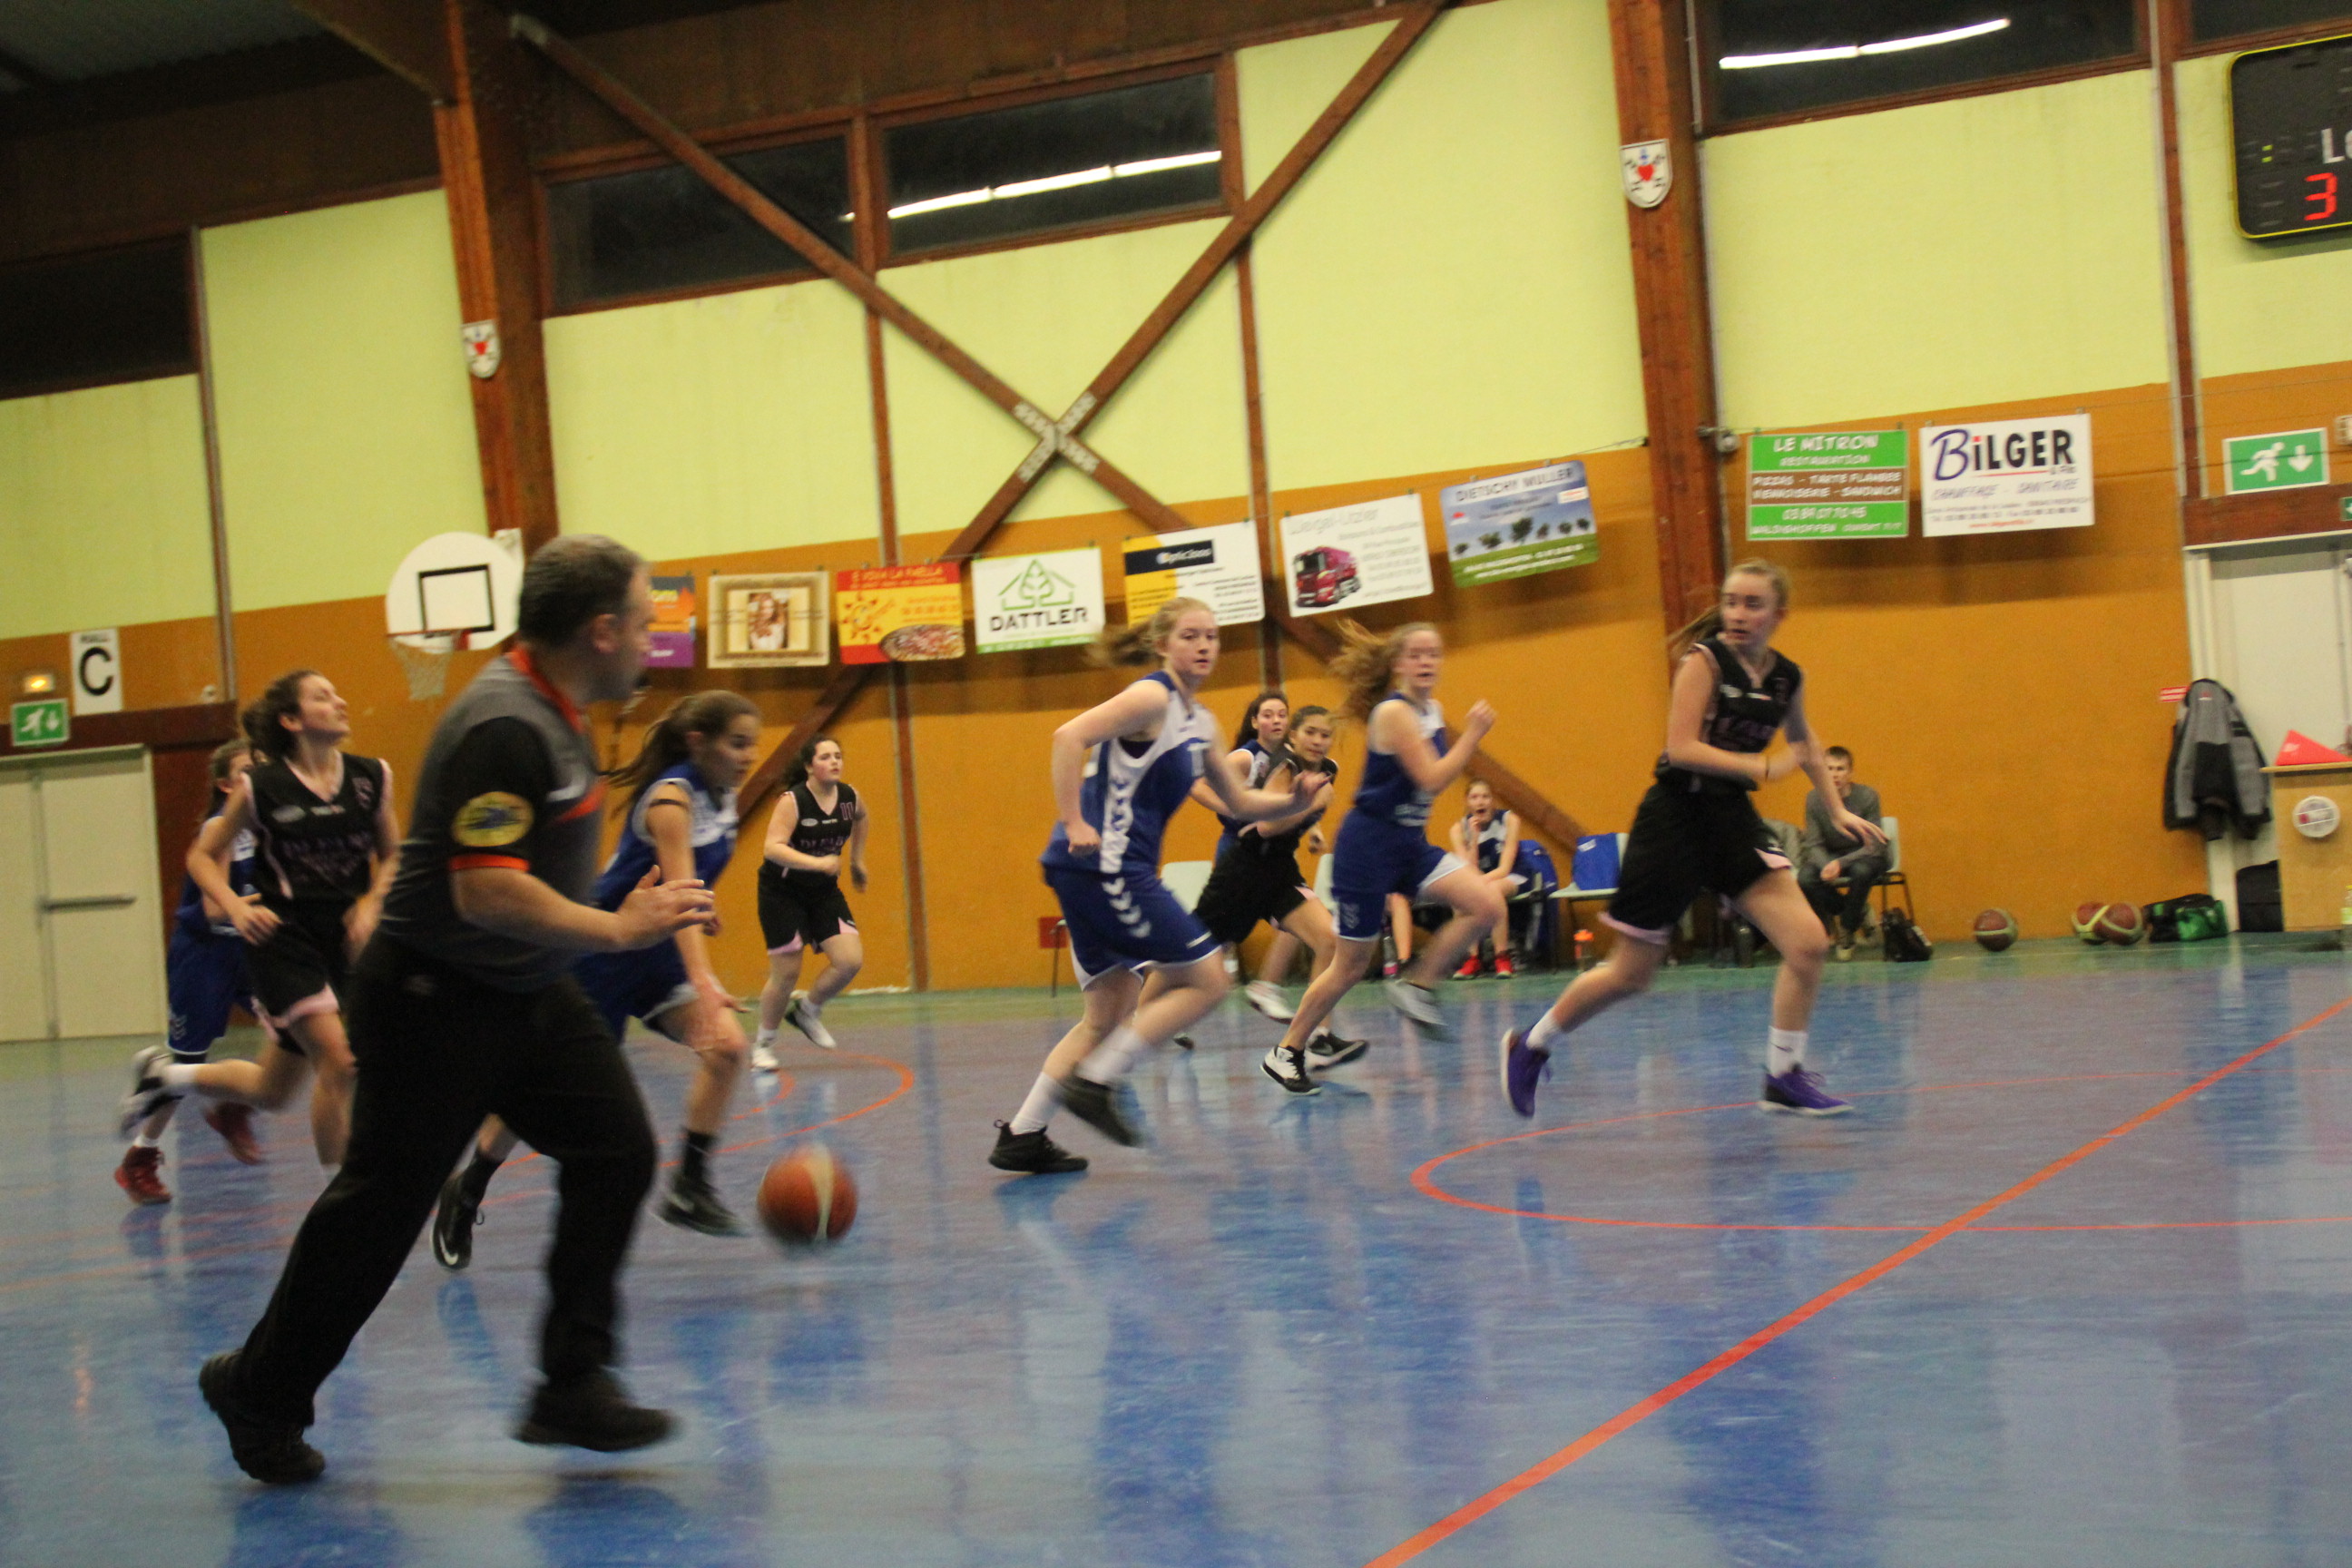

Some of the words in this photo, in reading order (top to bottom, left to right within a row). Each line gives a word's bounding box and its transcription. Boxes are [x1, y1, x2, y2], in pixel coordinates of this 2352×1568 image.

[1773, 437, 1797, 452] LE
[1800, 435, 1879, 452] MITRON
[1752, 475, 1795, 486] PIZZAS
[1808, 474, 1847, 485] TARTE
[1841, 485, 1903, 497] SANDWICH
[990, 607, 1088, 632] DATTLER
[80, 646, 113, 696] C
